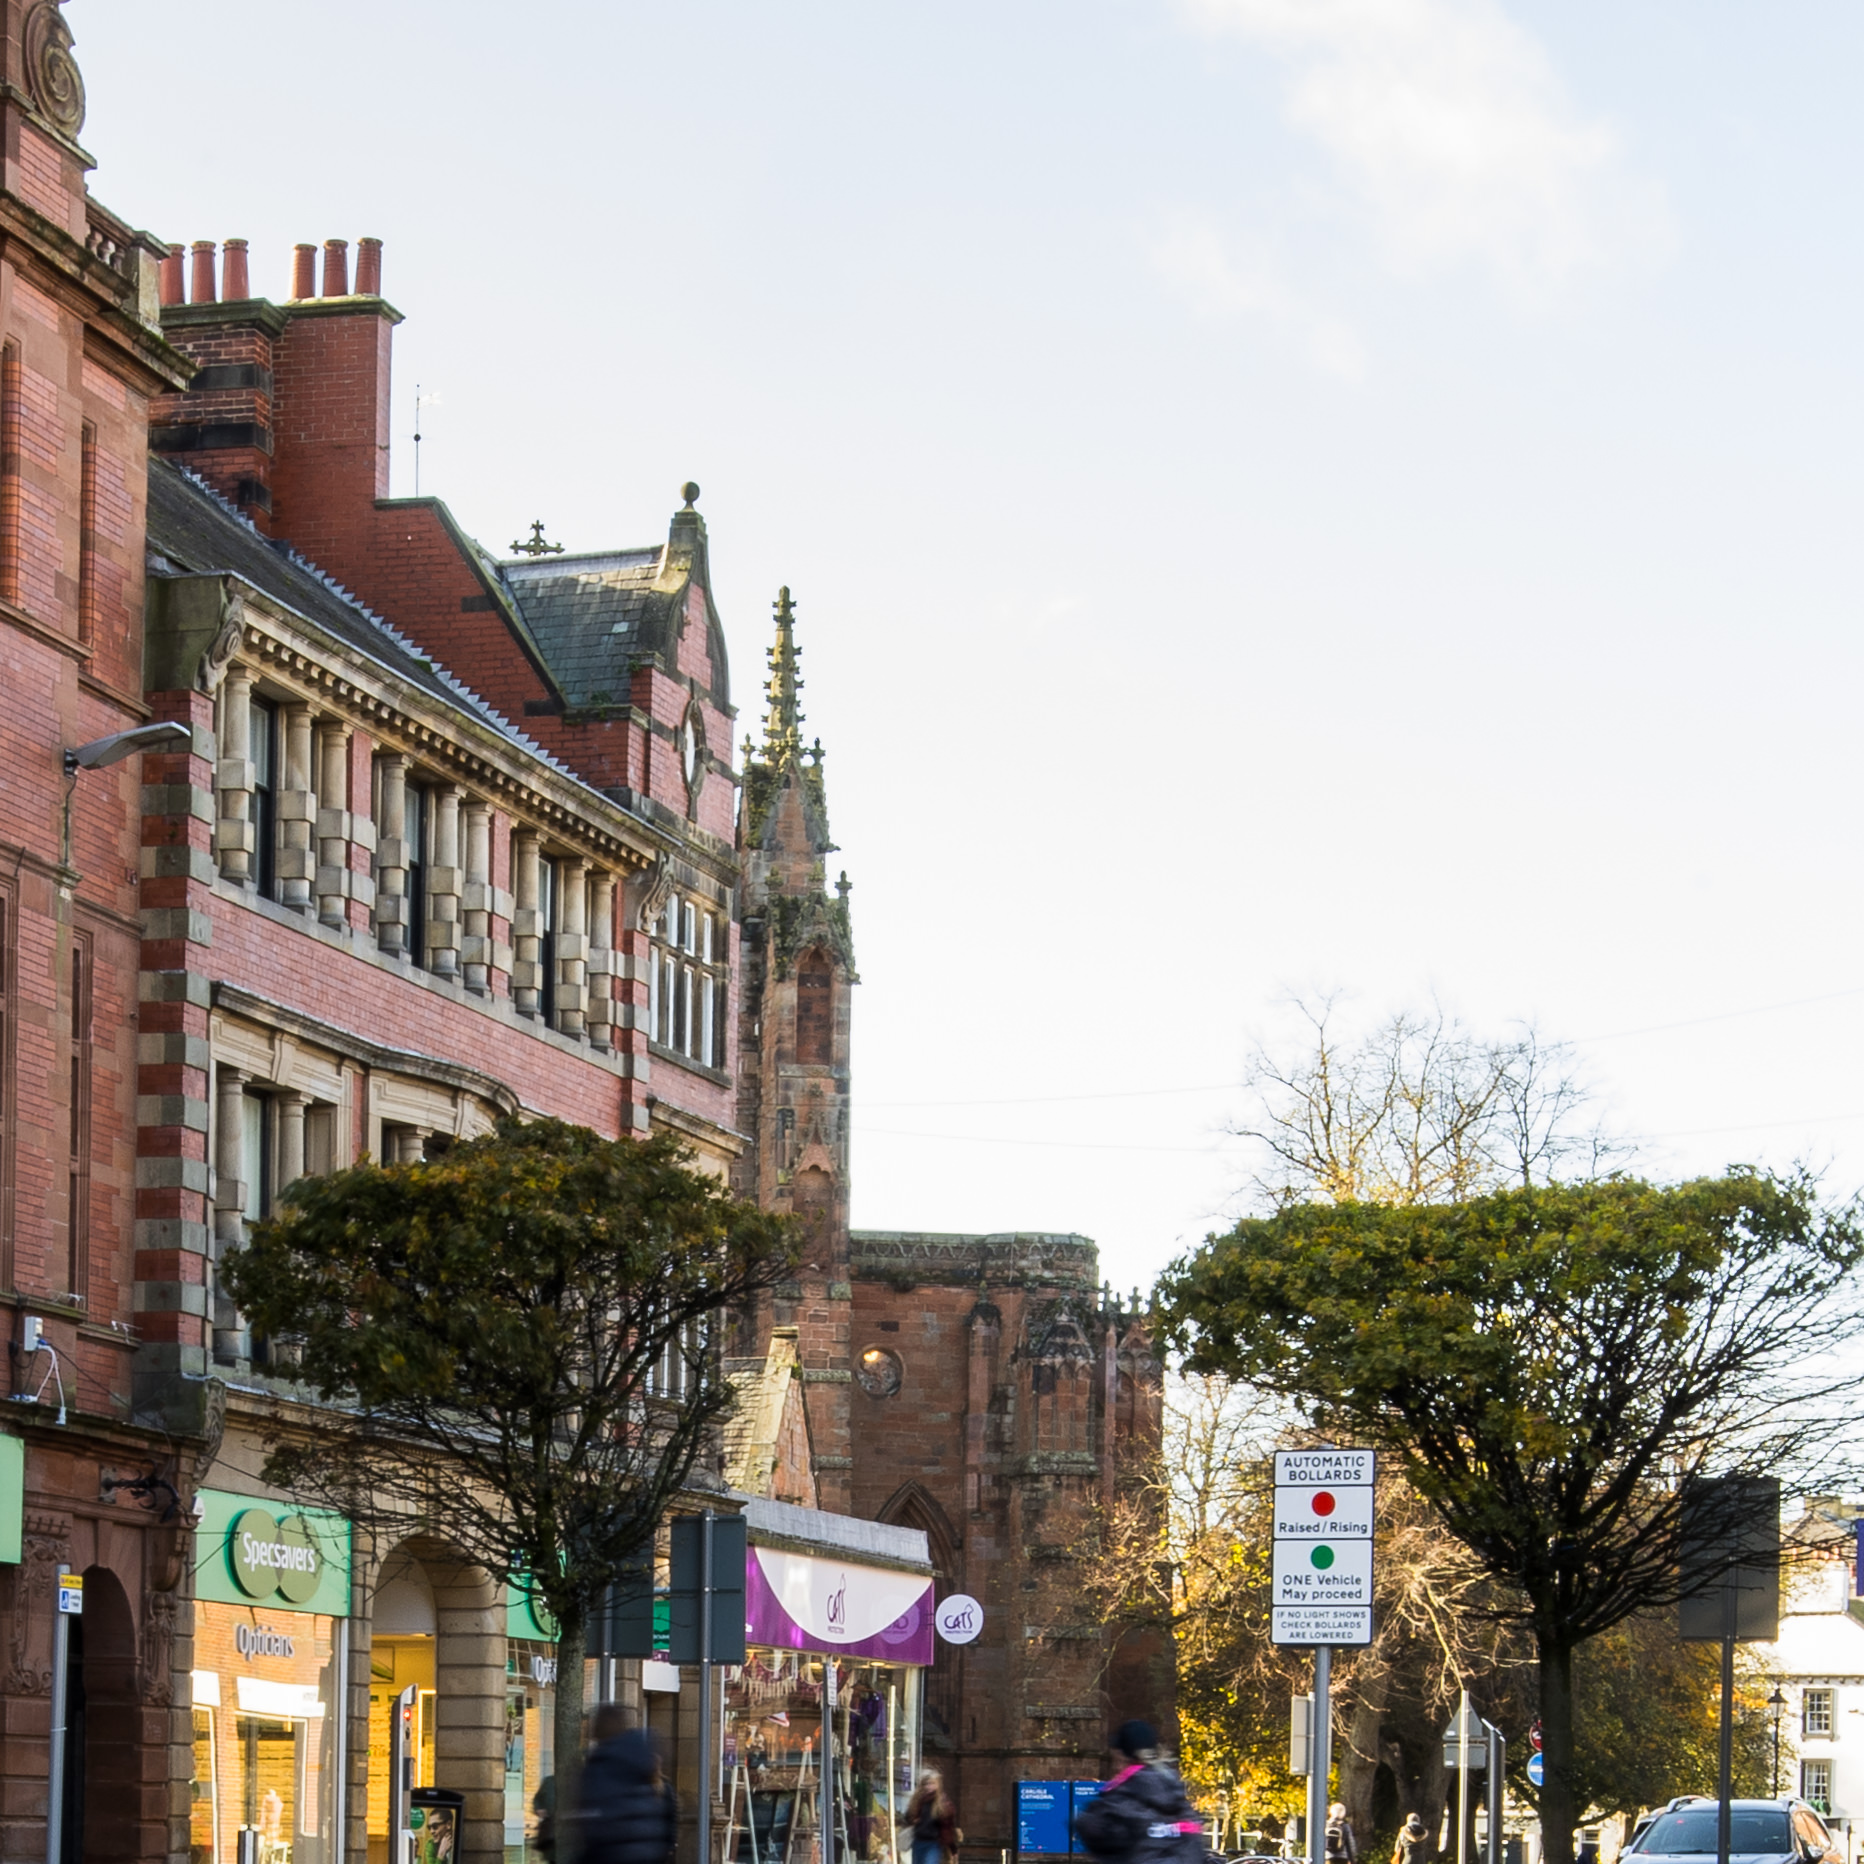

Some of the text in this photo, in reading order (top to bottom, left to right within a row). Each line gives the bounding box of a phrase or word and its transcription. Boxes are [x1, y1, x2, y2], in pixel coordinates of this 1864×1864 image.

[1283, 1456, 1366, 1468] AUTOMATIC
[1288, 1470, 1362, 1481] BOLLARDS
[1278, 1522, 1321, 1533] Raised
[1329, 1521, 1368, 1534] Rising
[242, 1531, 317, 1573] Specsavers
[1282, 1574, 1362, 1585] ONE Vehicle
[1282, 1588, 1363, 1601] May proceed
[944, 1604, 974, 1630] CATS
[1277, 1611, 1366, 1619] IF NO LIGHT SHOWS
[1280, 1621, 1362, 1629] CHECK BOLLARDS
[1289, 1631, 1354, 1639] ARE LOWERED
[236, 1623, 296, 1665] Opticians
